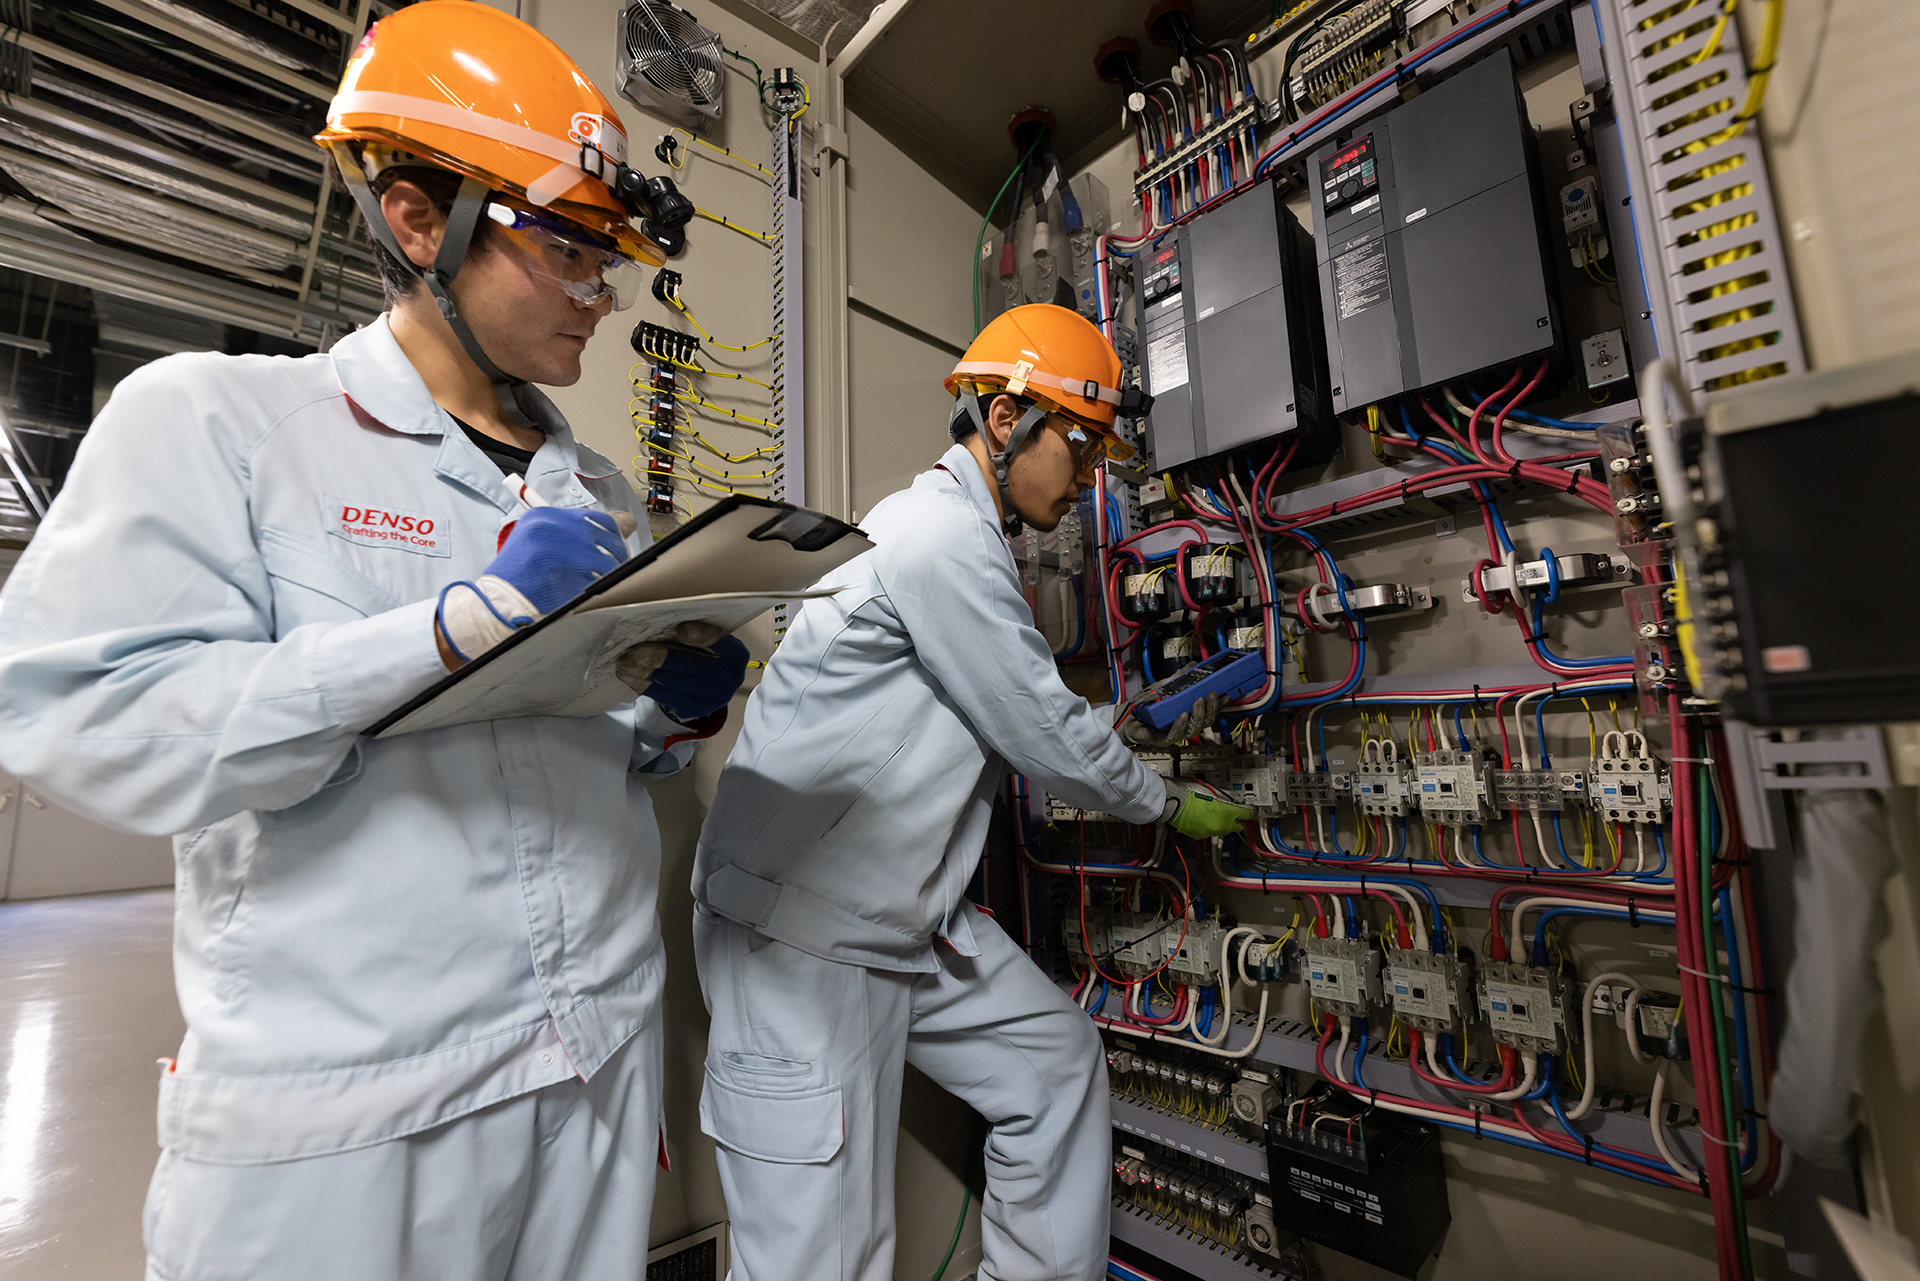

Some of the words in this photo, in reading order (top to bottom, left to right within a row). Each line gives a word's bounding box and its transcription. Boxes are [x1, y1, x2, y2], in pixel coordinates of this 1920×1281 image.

[341, 506, 434, 535] DENSO
[342, 524, 388, 540] Crafting
[389, 531, 409, 542] the
[410, 535, 436, 548] Core
